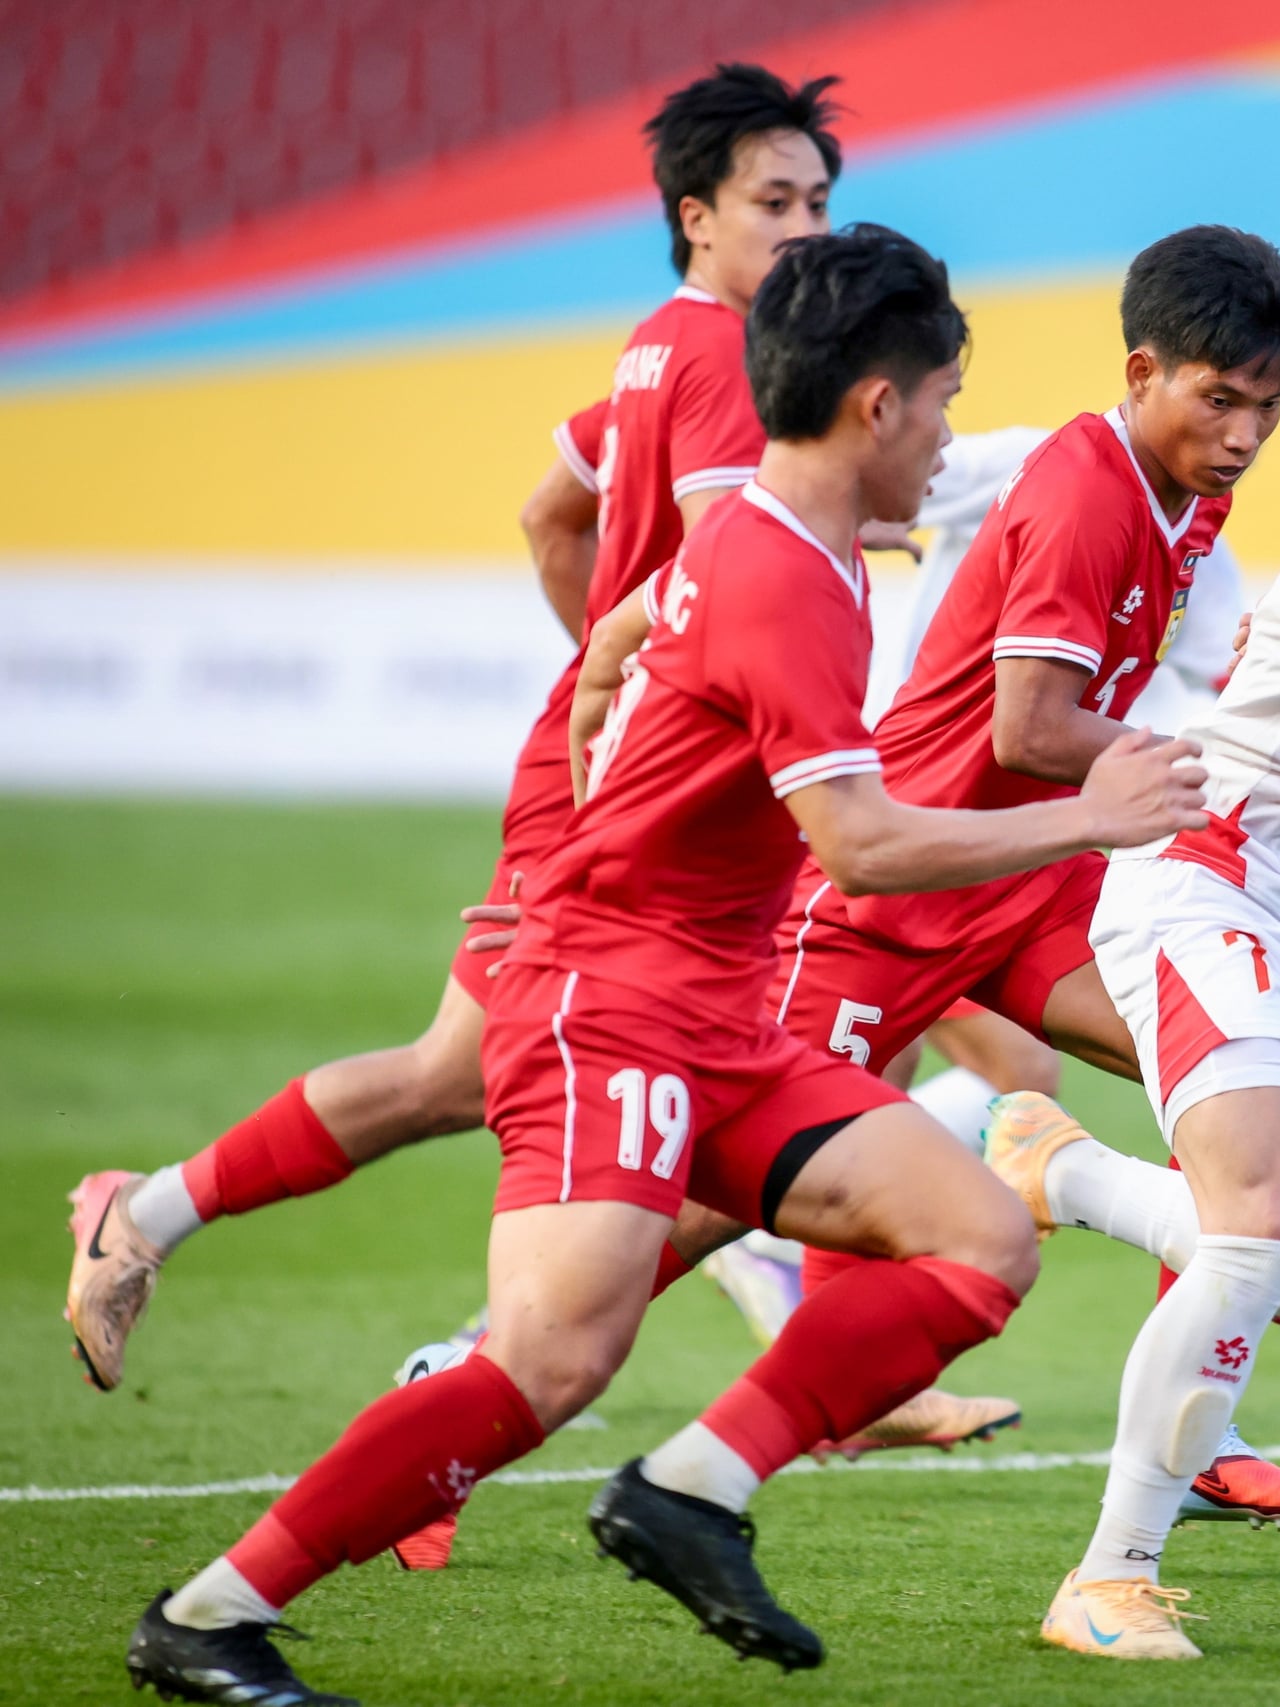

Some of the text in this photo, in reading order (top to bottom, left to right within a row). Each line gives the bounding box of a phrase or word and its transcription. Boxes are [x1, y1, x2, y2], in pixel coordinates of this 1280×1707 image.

[1222, 930, 1271, 994] 7
[828, 997, 883, 1069] 5
[606, 1067, 691, 1180] 19
